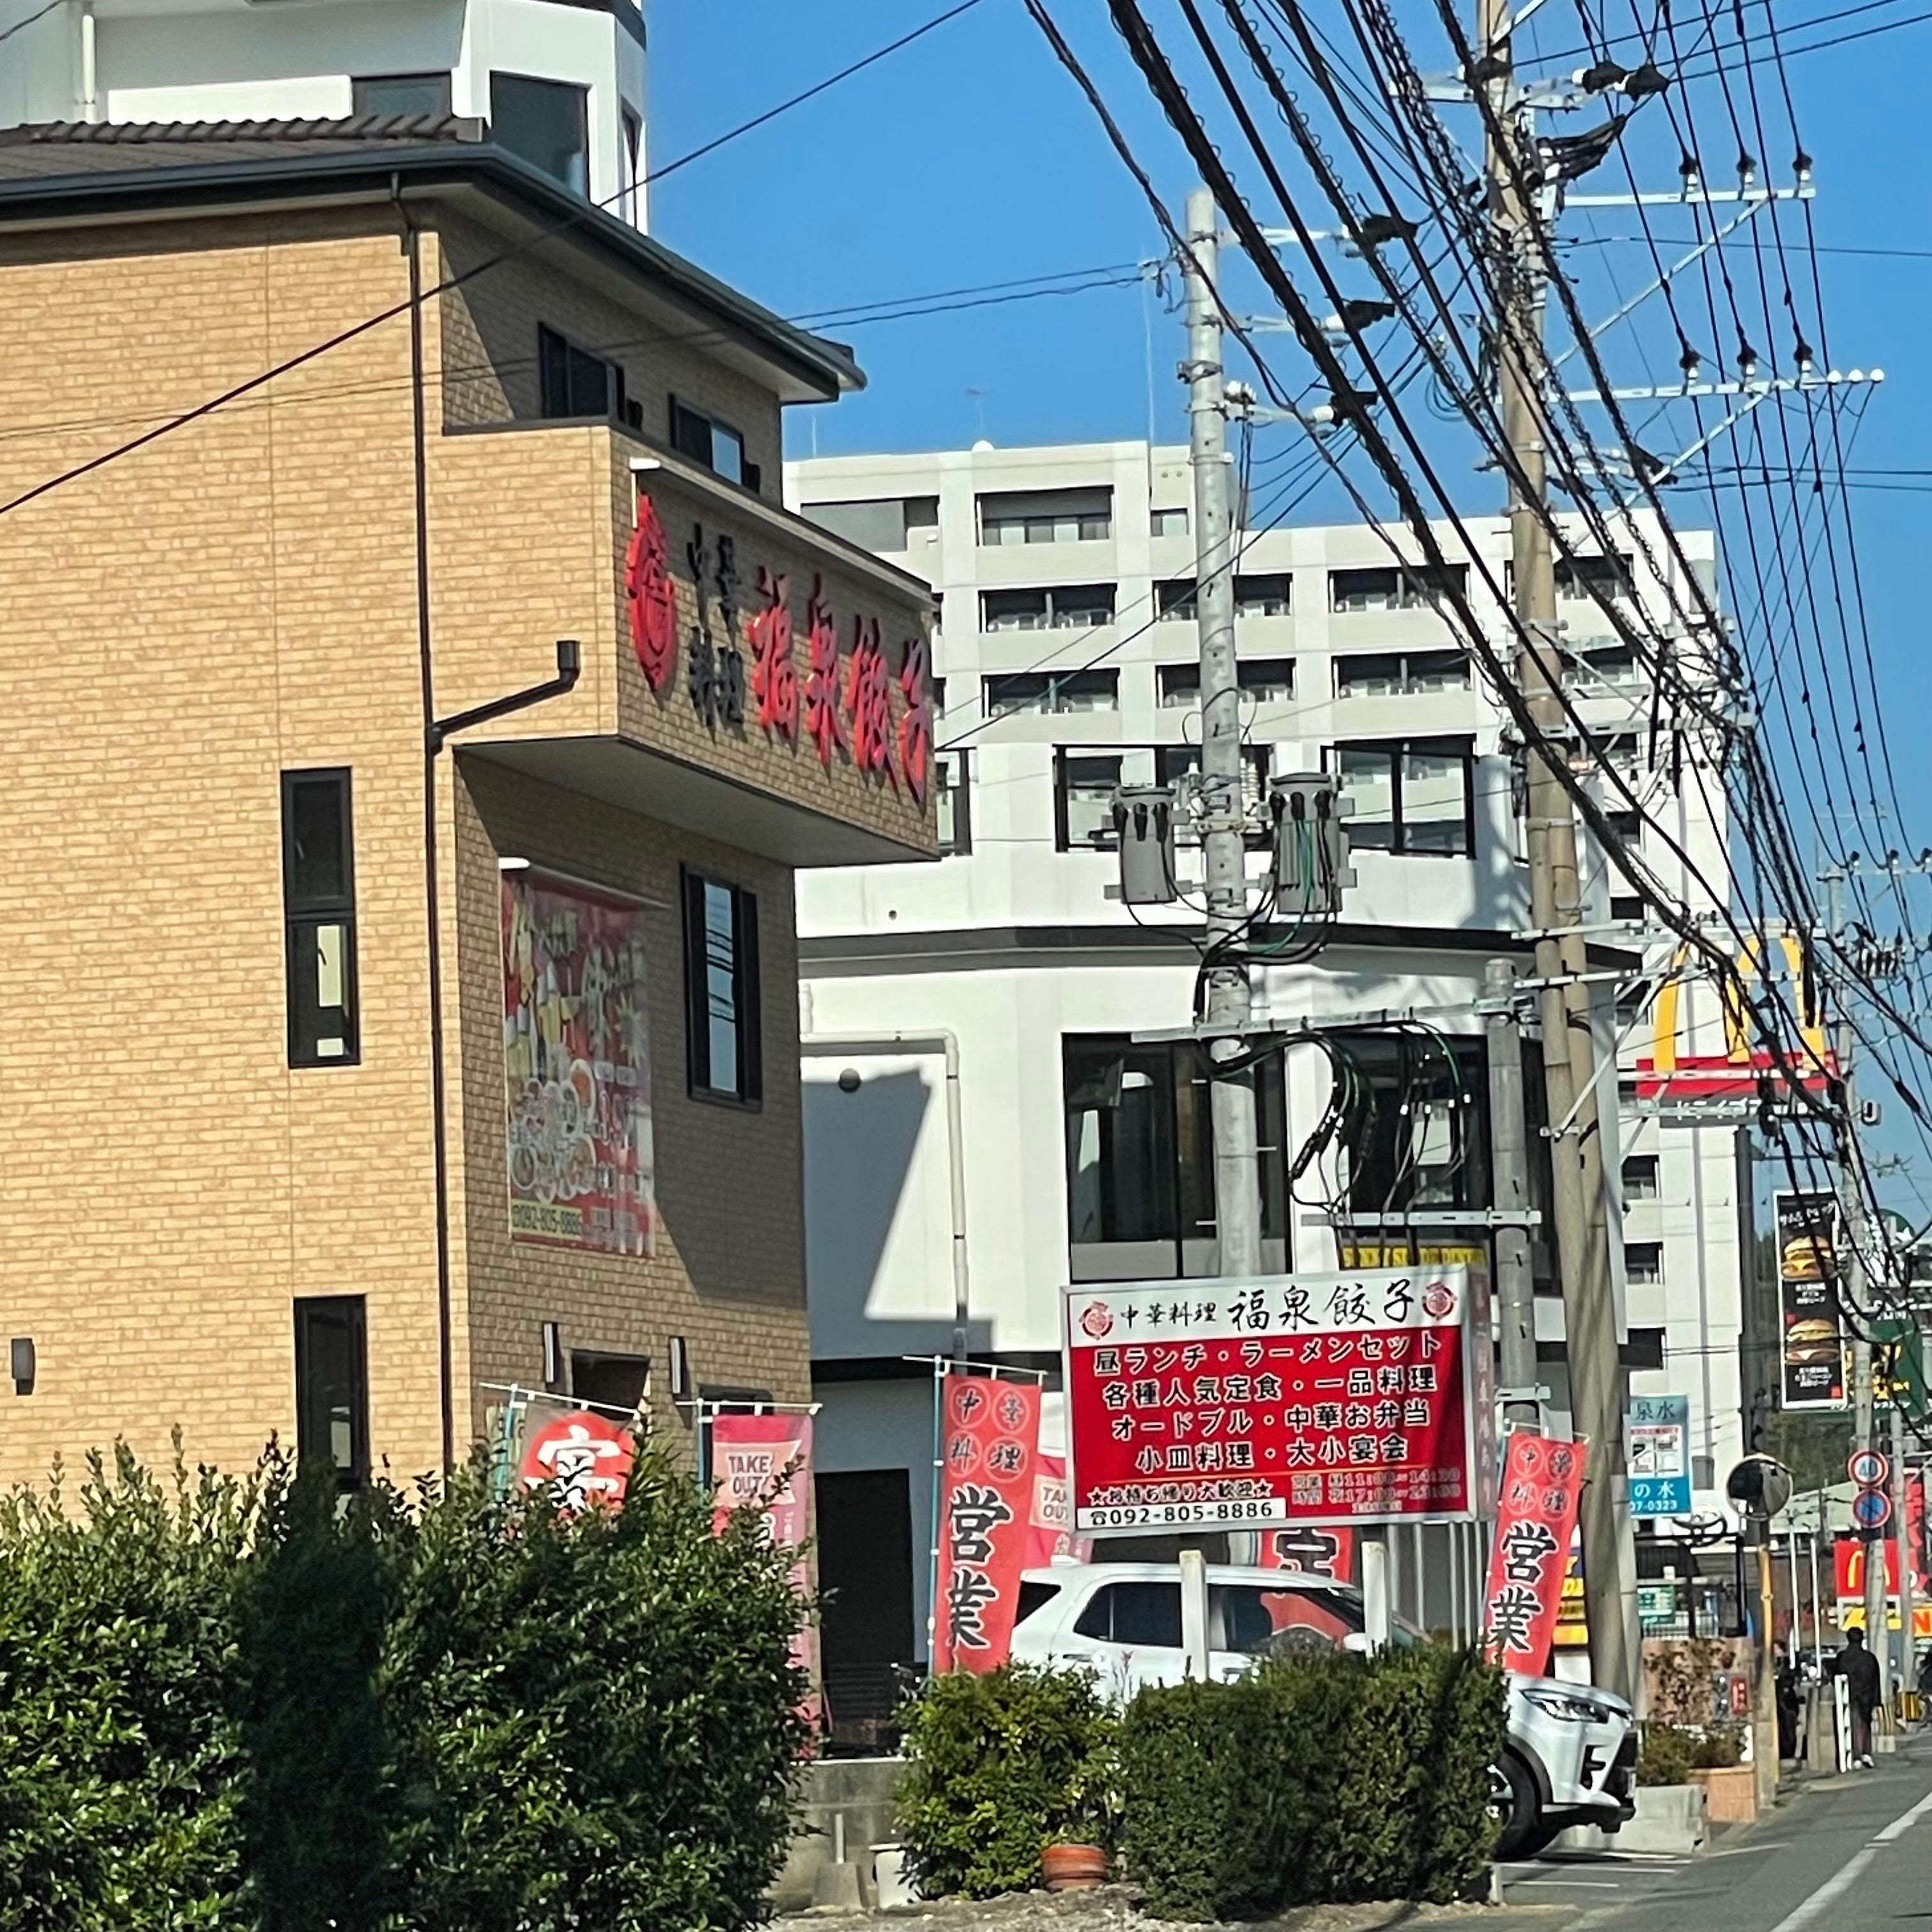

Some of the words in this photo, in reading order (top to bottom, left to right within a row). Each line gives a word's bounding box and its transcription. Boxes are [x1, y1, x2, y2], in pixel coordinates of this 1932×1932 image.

[1120, 1301, 1216, 1330] 中華料理
[1227, 1279, 1414, 1333] 福泉餃子
[1095, 1332, 1441, 1376] 昼ランチ・ラーメンセット
[1103, 1365, 1438, 1409] 各種人気定食・一品料理
[1112, 1398, 1430, 1441] オードブル・中華お弁当
[729, 1454, 770, 1474] TAKE
[1136, 1434, 1409, 1473] 小皿料理・大小宴会
[733, 1476, 762, 1494] OUT
[1490, 1521, 1558, 1653] 営業
